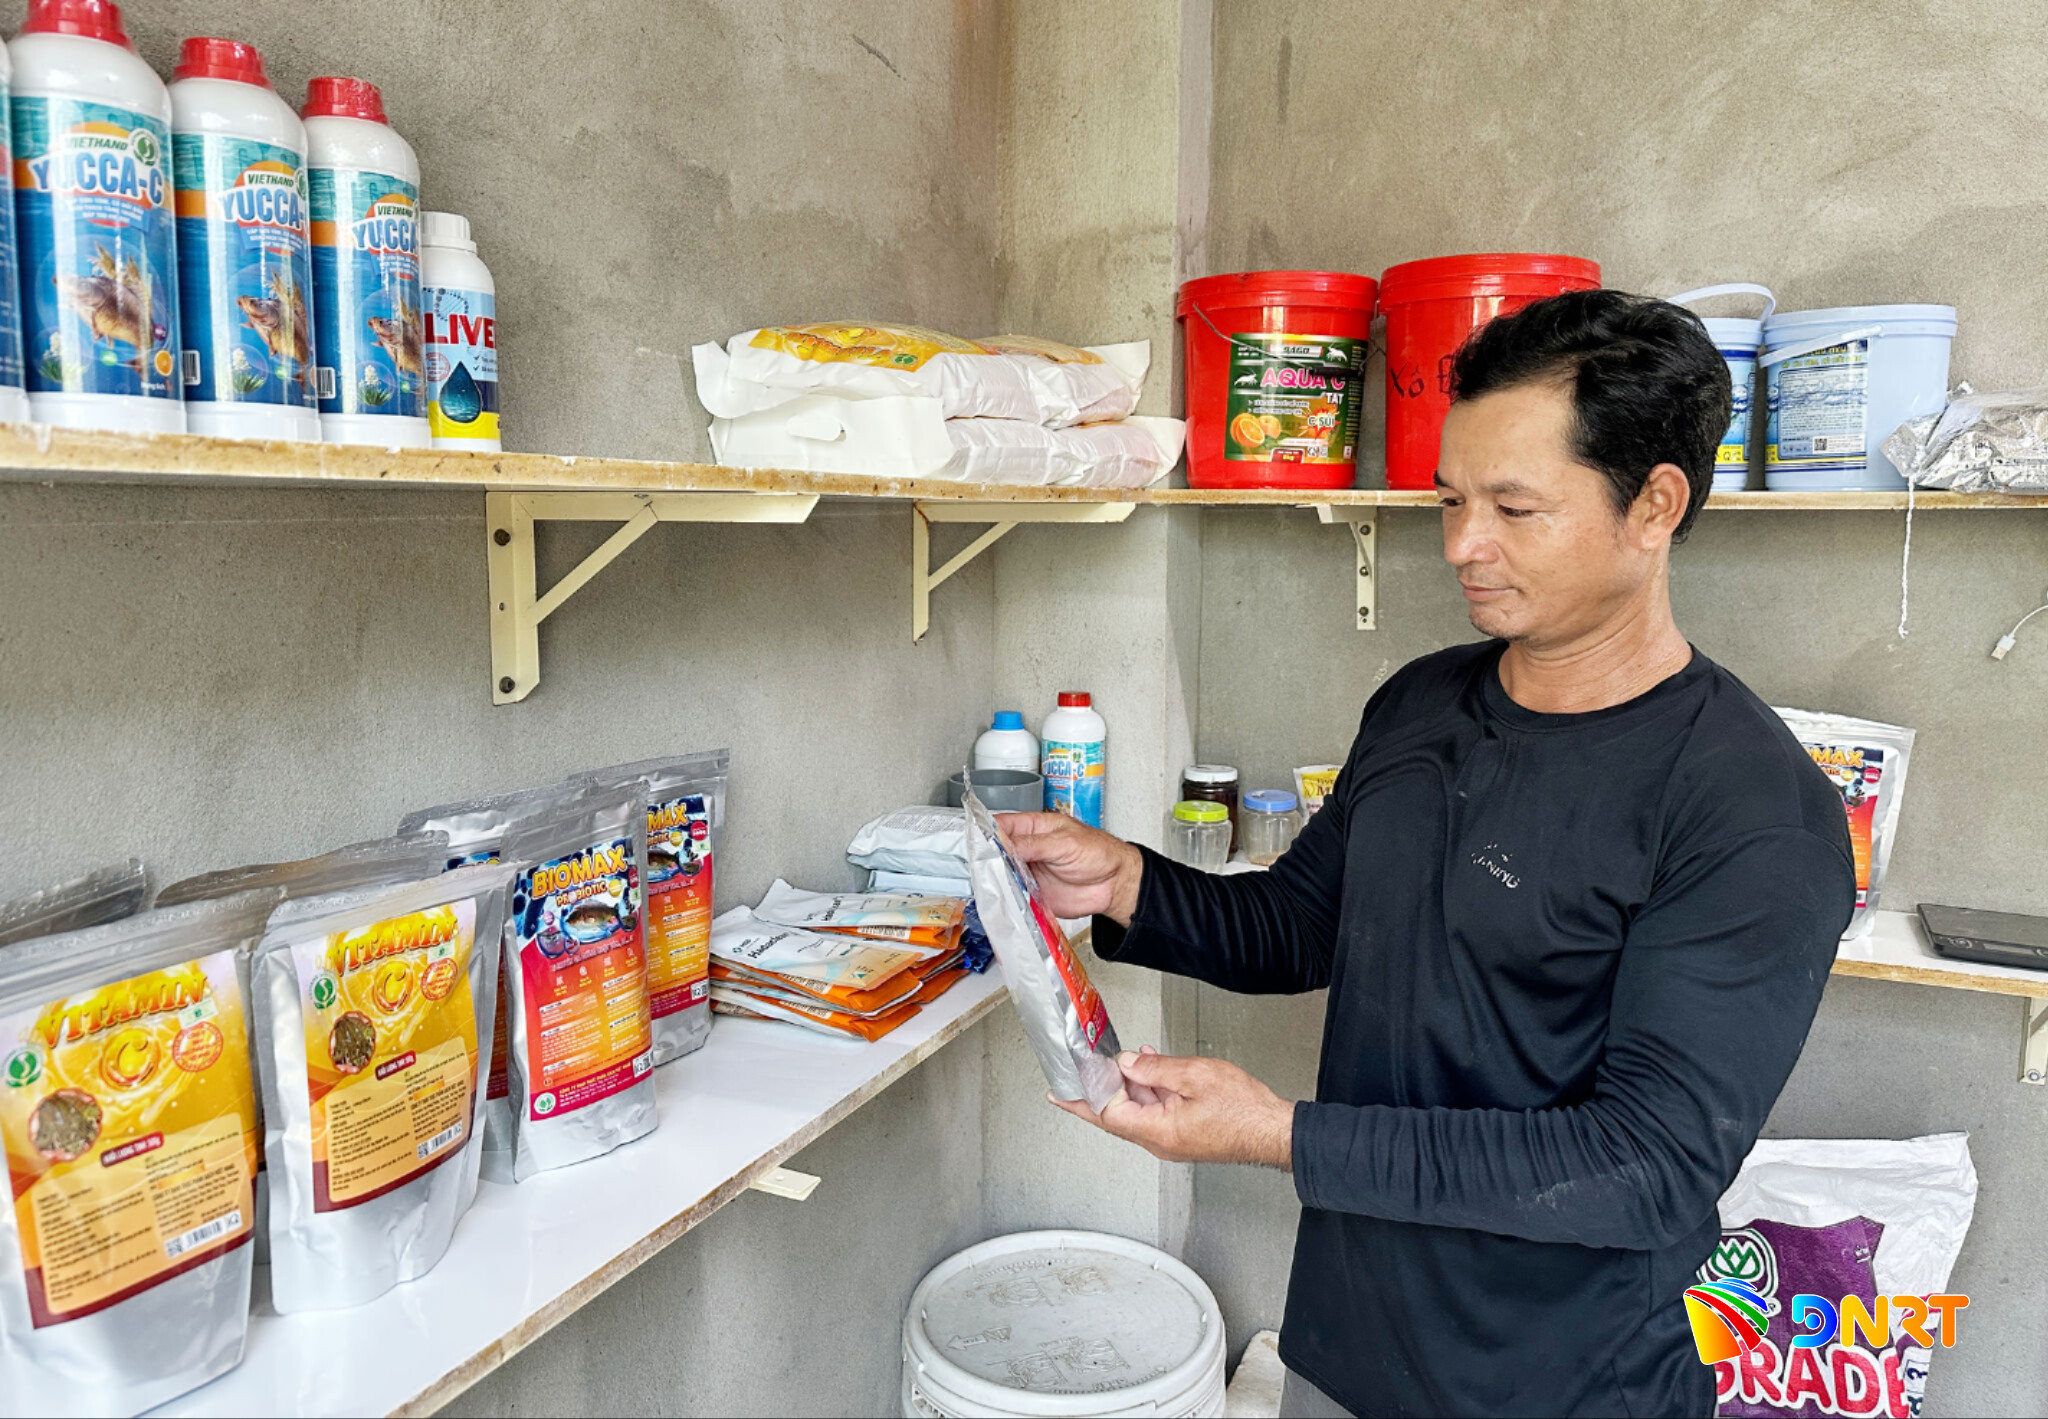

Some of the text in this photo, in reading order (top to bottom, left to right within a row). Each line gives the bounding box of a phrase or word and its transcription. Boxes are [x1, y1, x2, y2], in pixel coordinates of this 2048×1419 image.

[32, 152, 162, 205] YUCCA-C
[1260, 367, 1325, 389] AQUA
[1810, 748, 1863, 768] MAX
[647, 803, 688, 832] MAX
[531, 845, 627, 899] BIOMAX
[326, 916, 457, 977] VITAMIN
[37, 971, 208, 1050] VITAMIN
